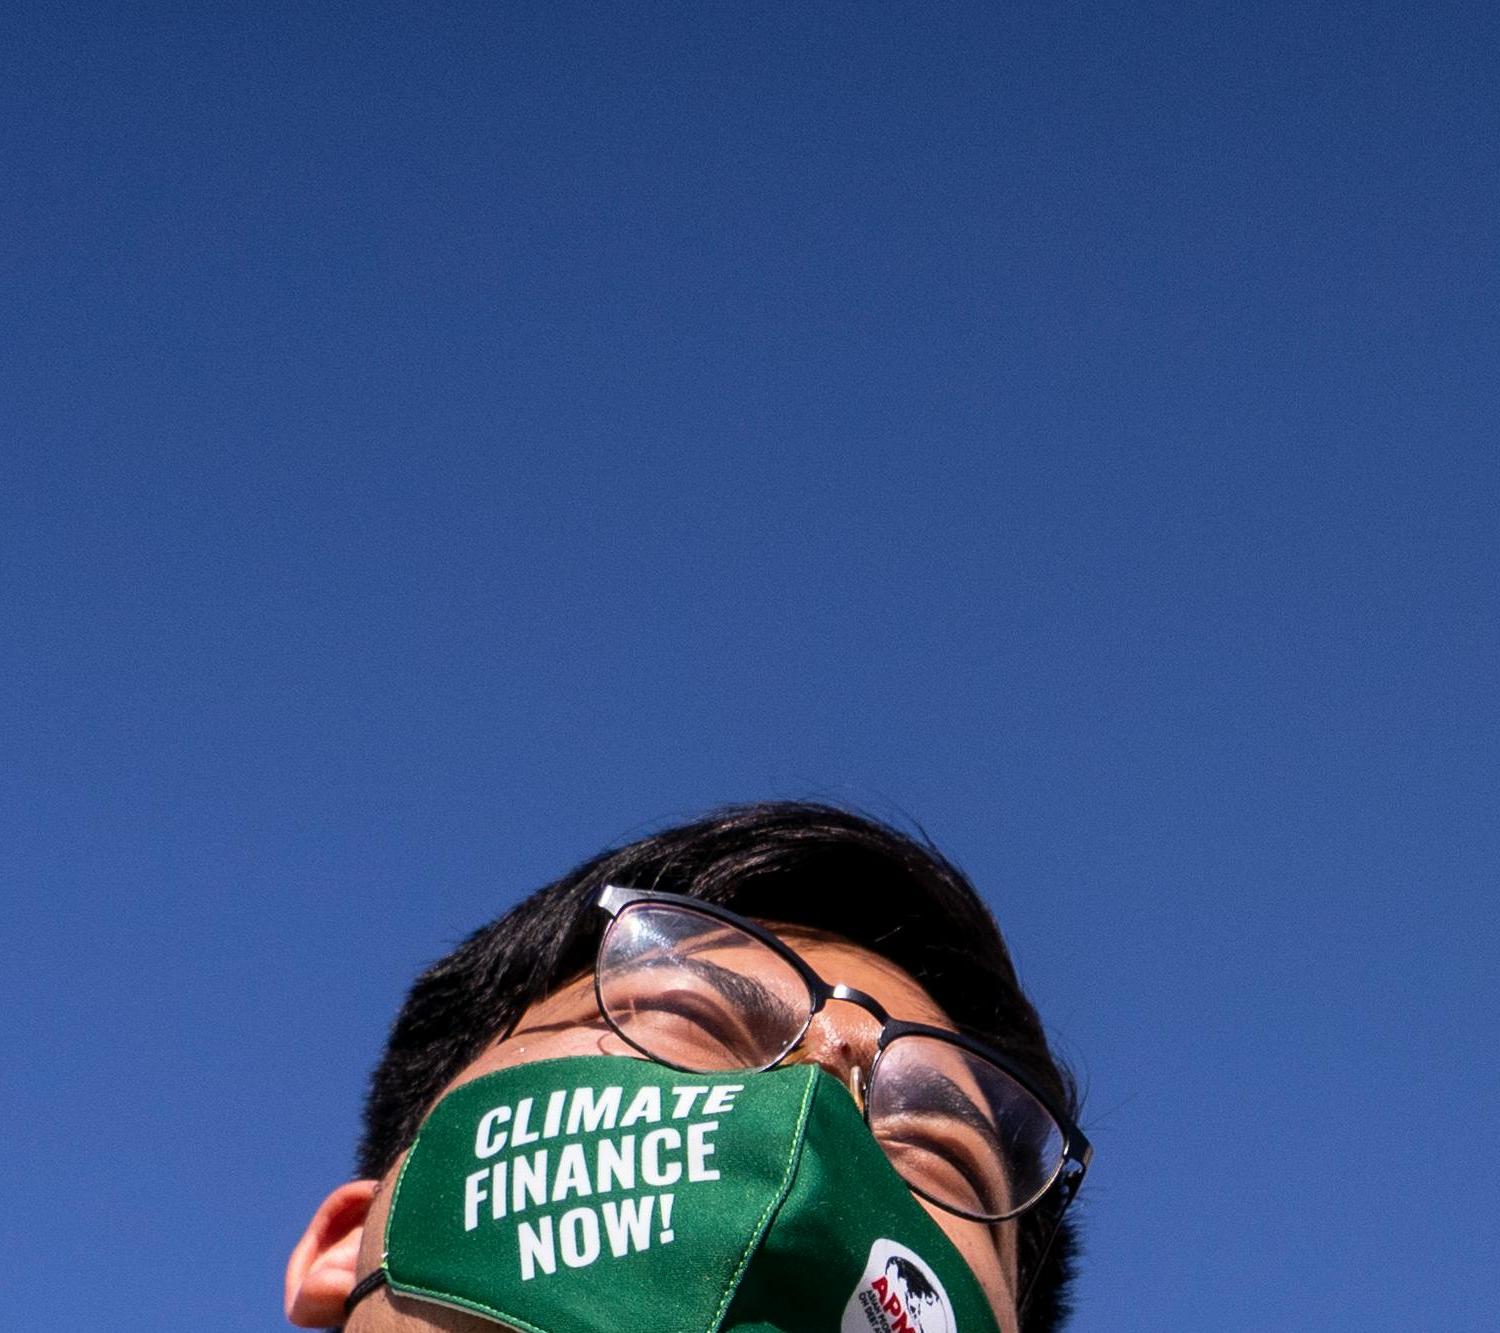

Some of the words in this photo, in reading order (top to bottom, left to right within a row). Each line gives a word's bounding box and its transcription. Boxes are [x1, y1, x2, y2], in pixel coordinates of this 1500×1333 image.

[474, 1084, 745, 1160] CLIMATE
[464, 1120, 721, 1232] FINANCE
[517, 1193, 675, 1282] NOW!
